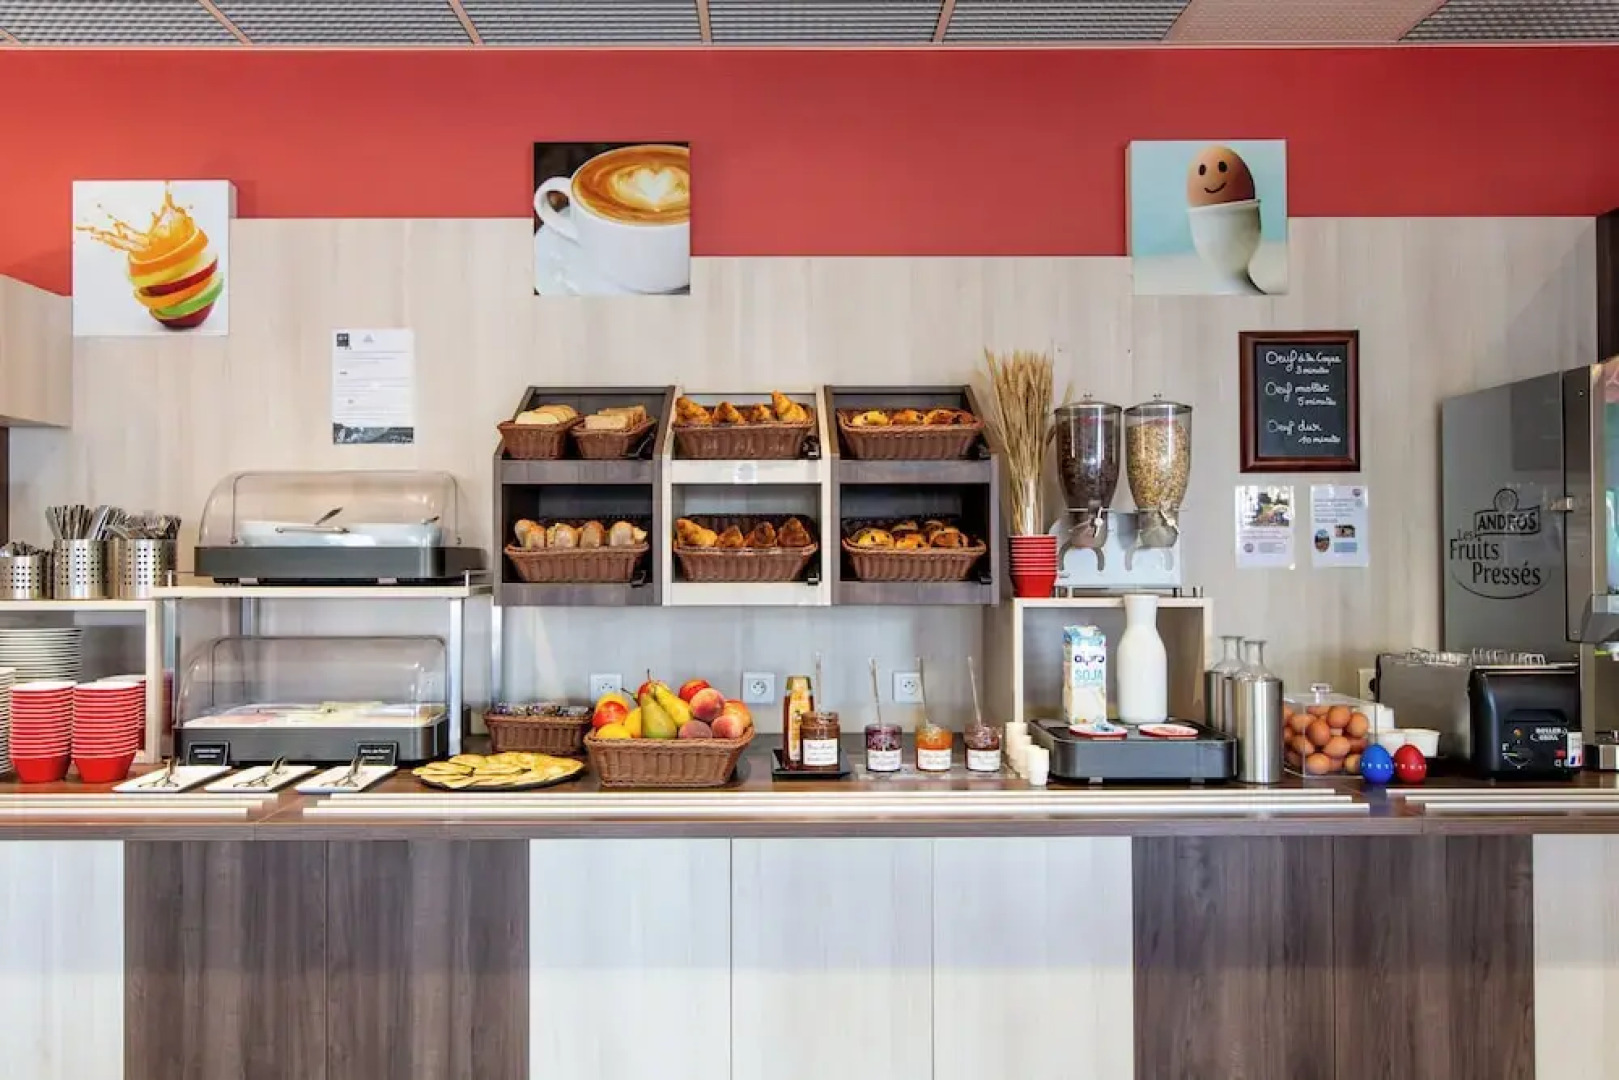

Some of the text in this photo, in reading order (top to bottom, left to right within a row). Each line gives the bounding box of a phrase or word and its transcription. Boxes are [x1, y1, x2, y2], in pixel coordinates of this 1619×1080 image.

[1477, 513, 1536, 531] ANDROS
[1457, 529, 1475, 541] Les
[1450, 537, 1499, 560] Fruits
[1472, 560, 1541, 585] Pressés
[1075, 669, 1103, 681] SOJA
